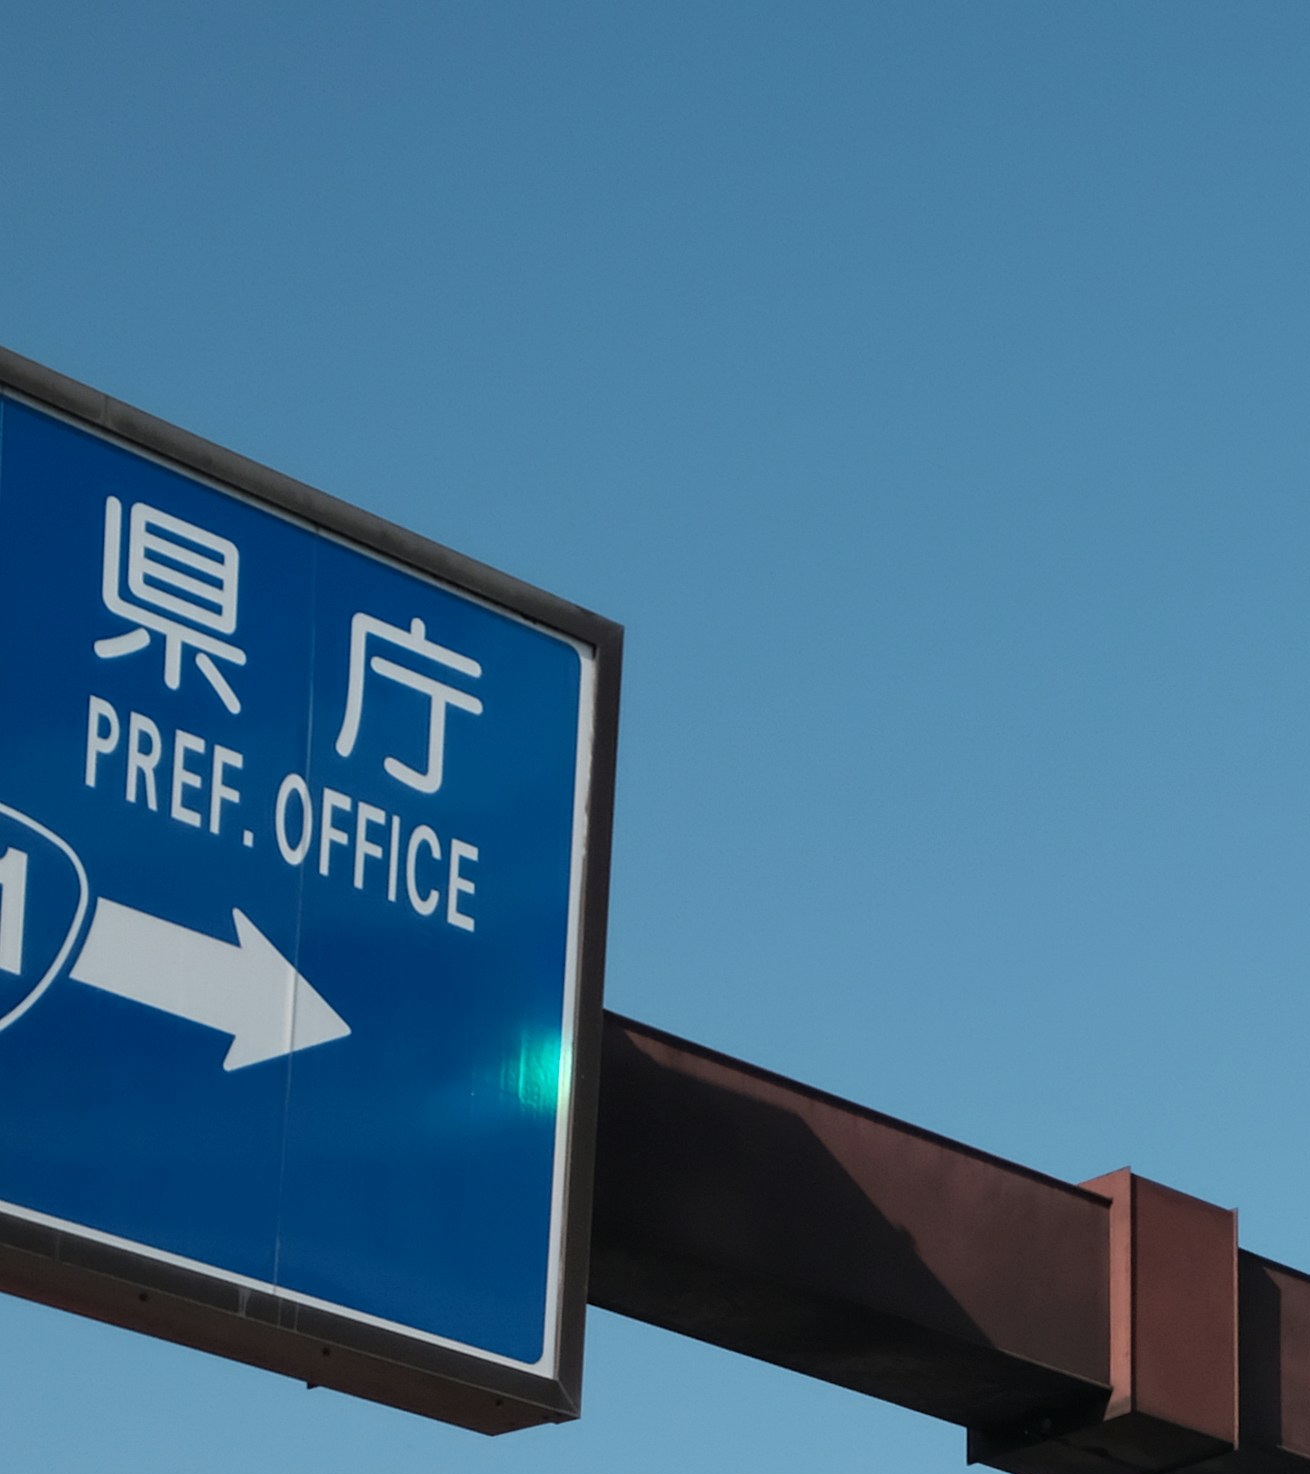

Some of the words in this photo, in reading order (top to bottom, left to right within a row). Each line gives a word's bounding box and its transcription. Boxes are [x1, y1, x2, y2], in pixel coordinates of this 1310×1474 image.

[94, 495, 484, 795] 県庁
[85, 695, 255, 848] PREF.
[275, 773, 480, 933] OFFICE
